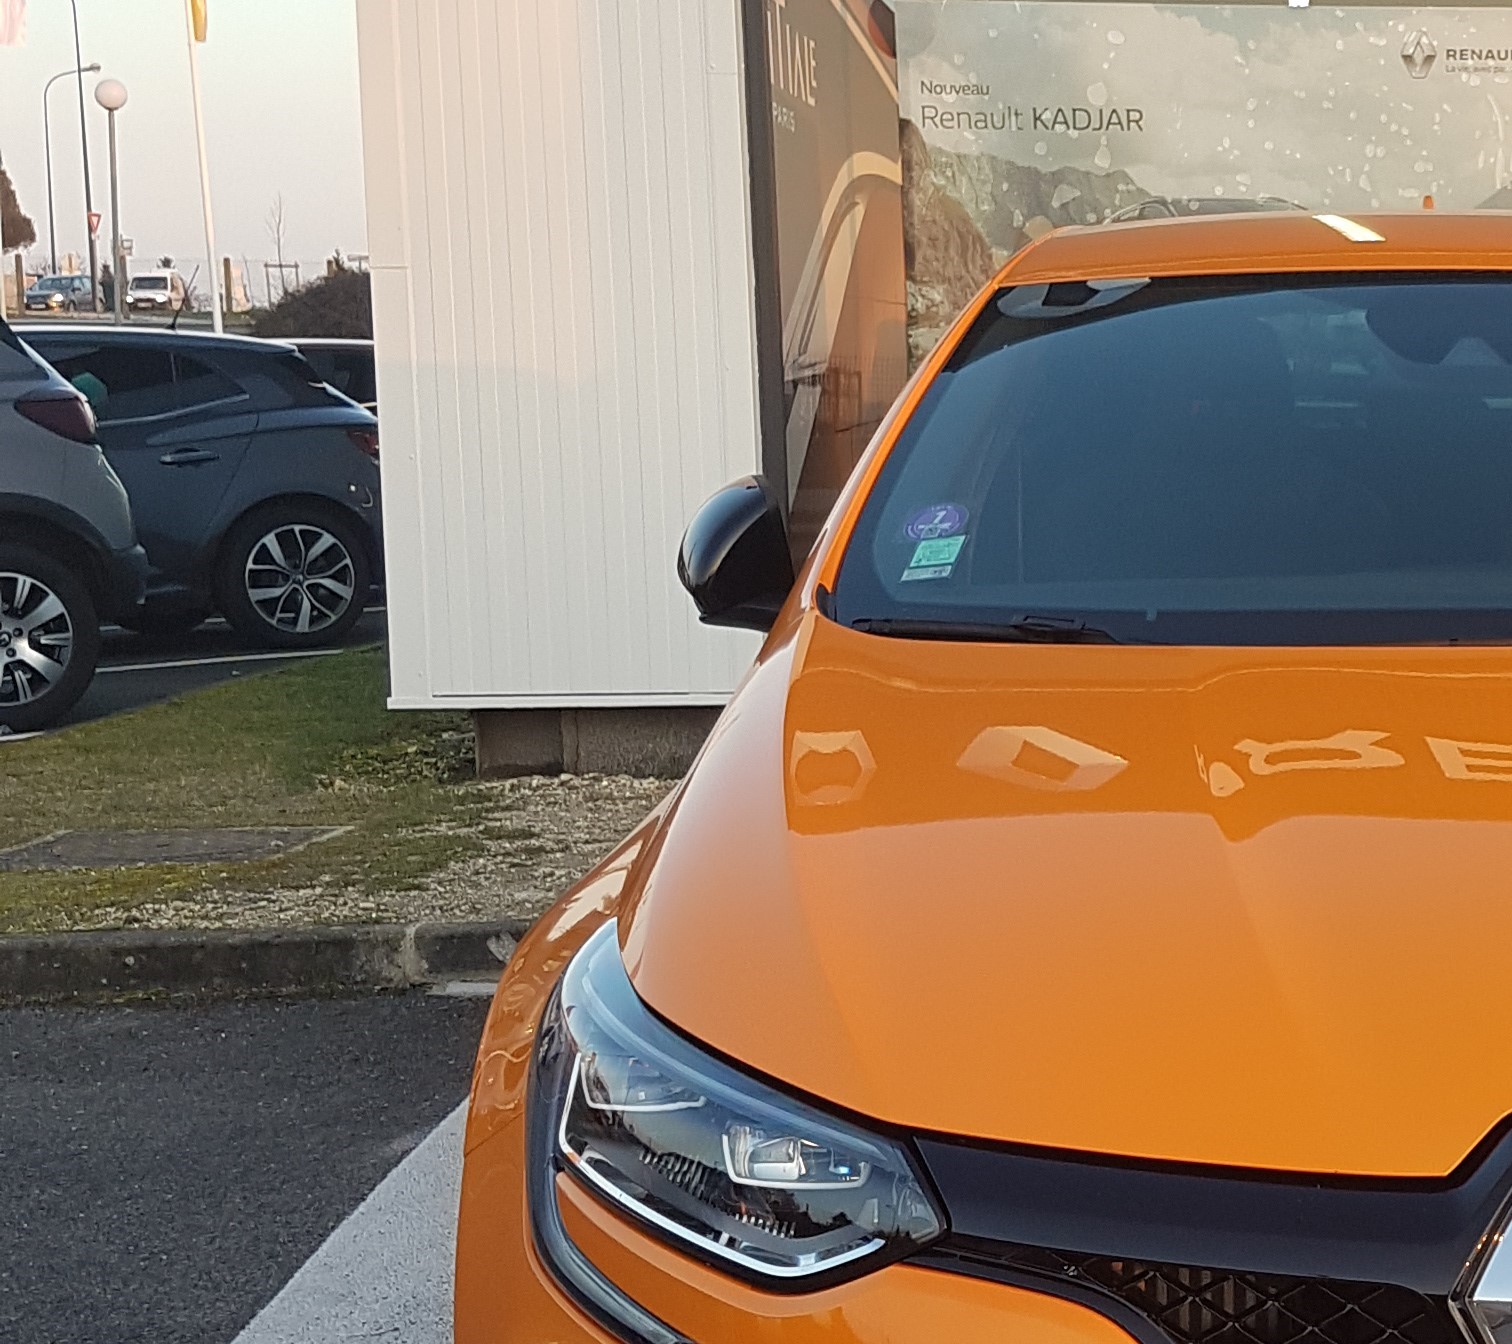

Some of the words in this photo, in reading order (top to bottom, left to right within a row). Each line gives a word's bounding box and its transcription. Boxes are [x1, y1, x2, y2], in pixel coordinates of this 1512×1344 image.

[920, 80, 990, 96] Nouveau
[921, 105, 1024, 131] Renault
[1032, 107, 1144, 132] KADJAR
